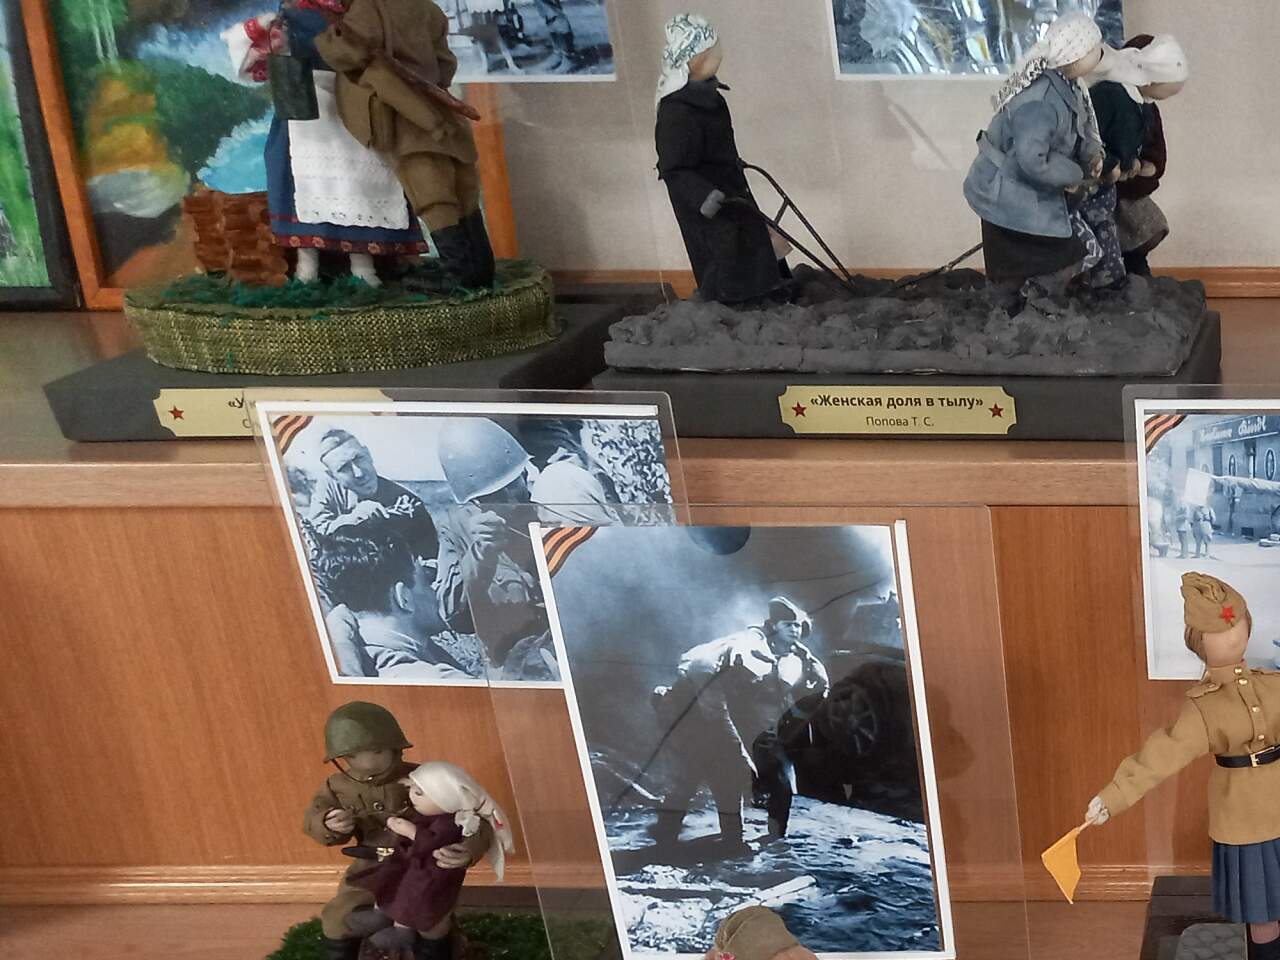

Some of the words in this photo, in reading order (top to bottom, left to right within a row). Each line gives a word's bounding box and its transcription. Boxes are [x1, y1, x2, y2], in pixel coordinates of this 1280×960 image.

[810, 394, 883, 407] «Женская
[887, 396, 922, 410] доля
[926, 396, 935, 407] в
[939, 396, 984, 410] тылу»
[866, 416, 909, 428] Попова
[923, 416, 935, 427] С.
